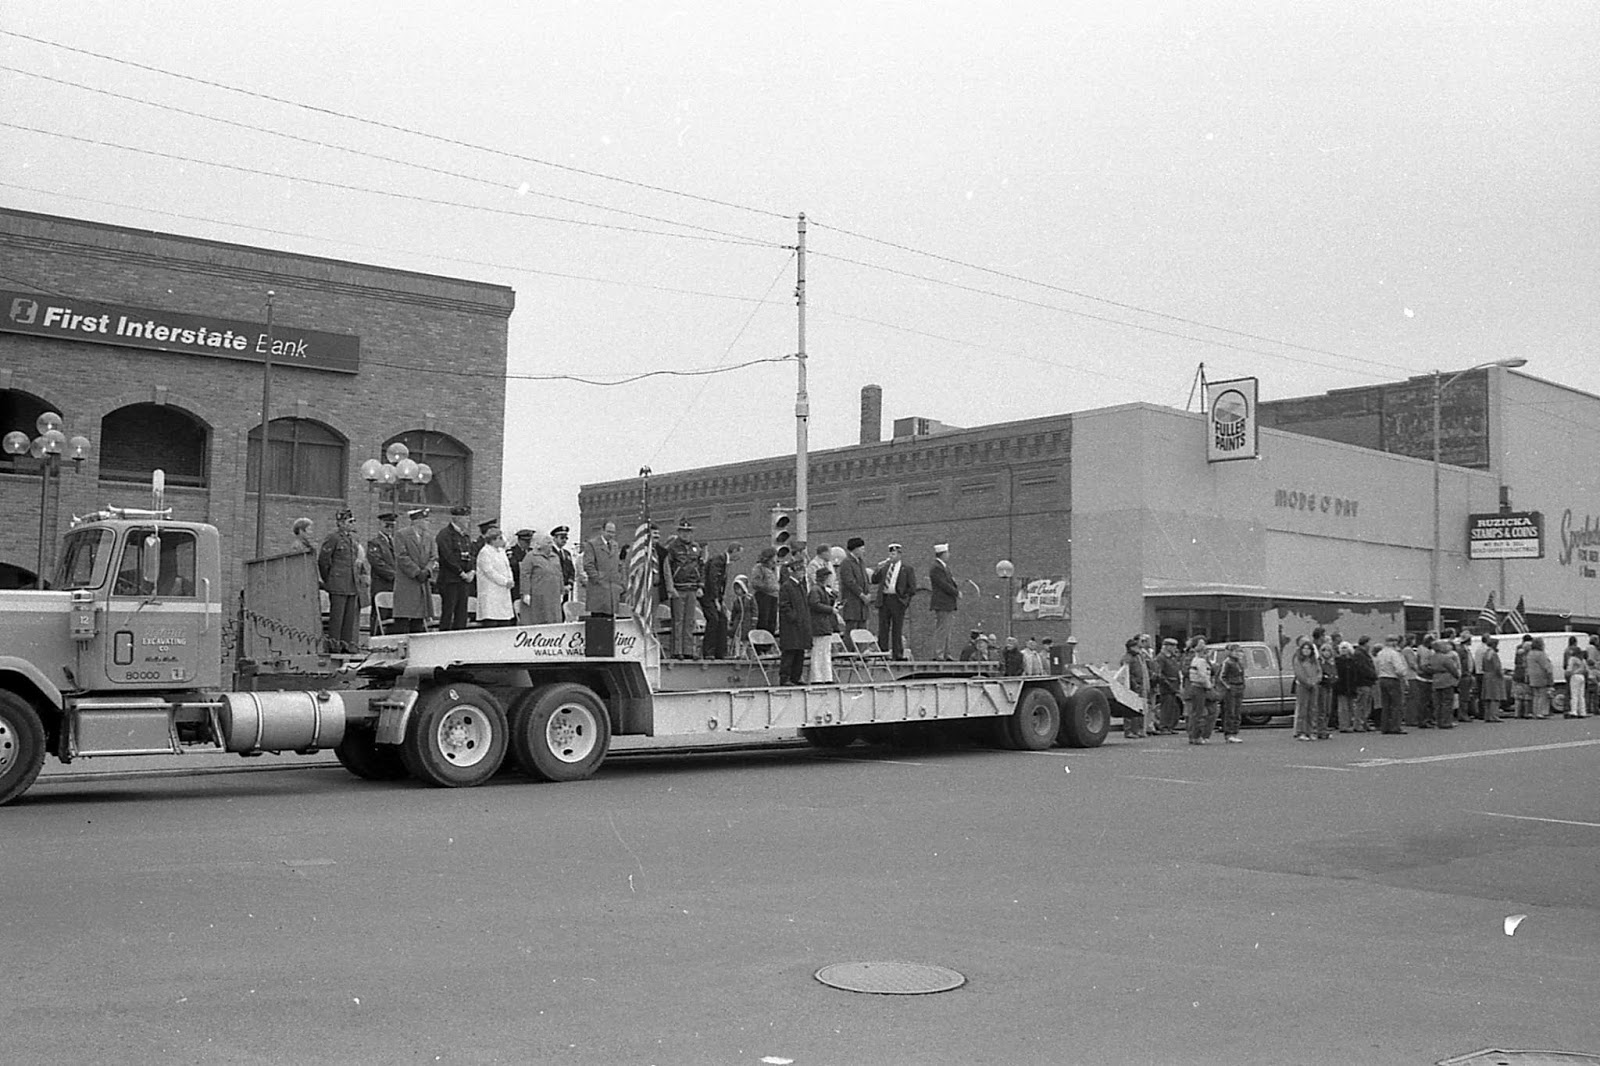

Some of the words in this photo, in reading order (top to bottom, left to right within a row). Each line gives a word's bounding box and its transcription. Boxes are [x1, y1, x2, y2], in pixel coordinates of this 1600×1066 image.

[43, 306, 109, 333] First
[116, 316, 248, 350] Interstate
[256, 333, 308, 358] Bank
[1215, 418, 1245, 437] FULLER
[1215, 432, 1245, 451] PAINTS
[1275, 489, 1316, 512] MODE
[1477, 517, 1533, 528] RUZICKA
[1470, 528, 1503, 540] STAMPS
[1504, 527, 1511, 538] &
[1511, 526, 1538, 538] COINS
[80, 615, 89, 625] 12
[142, 637, 187, 645] EXCAVATING
[514, 631, 566, 649] Inland
[533, 648, 563, 657] WALLA
[126, 671, 160, 681] 80000
